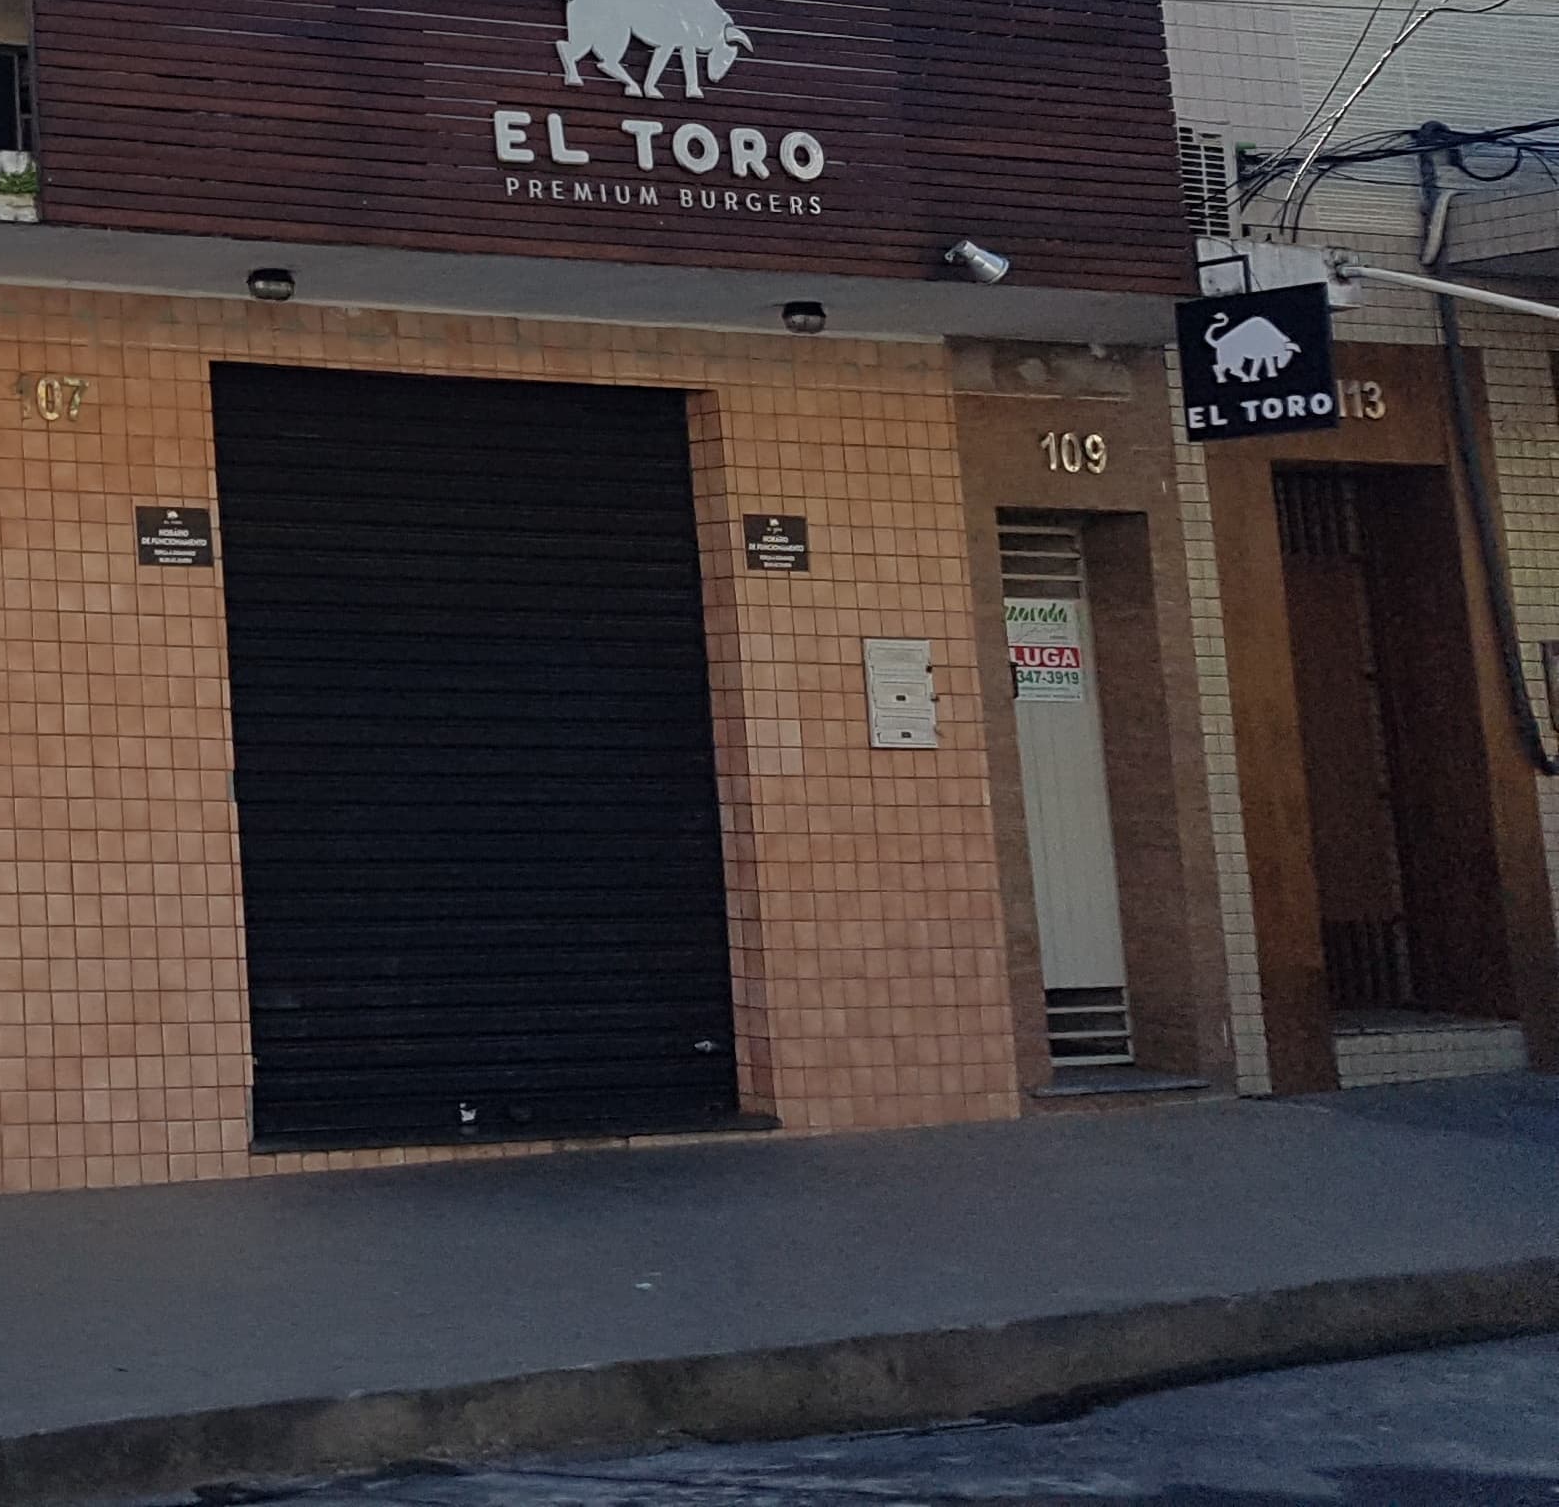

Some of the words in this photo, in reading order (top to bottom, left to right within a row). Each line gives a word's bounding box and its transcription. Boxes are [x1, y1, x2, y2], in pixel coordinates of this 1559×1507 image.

[494, 110, 590, 165] EL
[621, 118, 825, 183] TORO
[505, 177, 659, 207] PREMIUM
[680, 188, 822, 216] BURGERS
[1188, 404, 1229, 430] EL
[1240, 392, 1333, 422] TORO
[1040, 431, 1107, 474] 109
